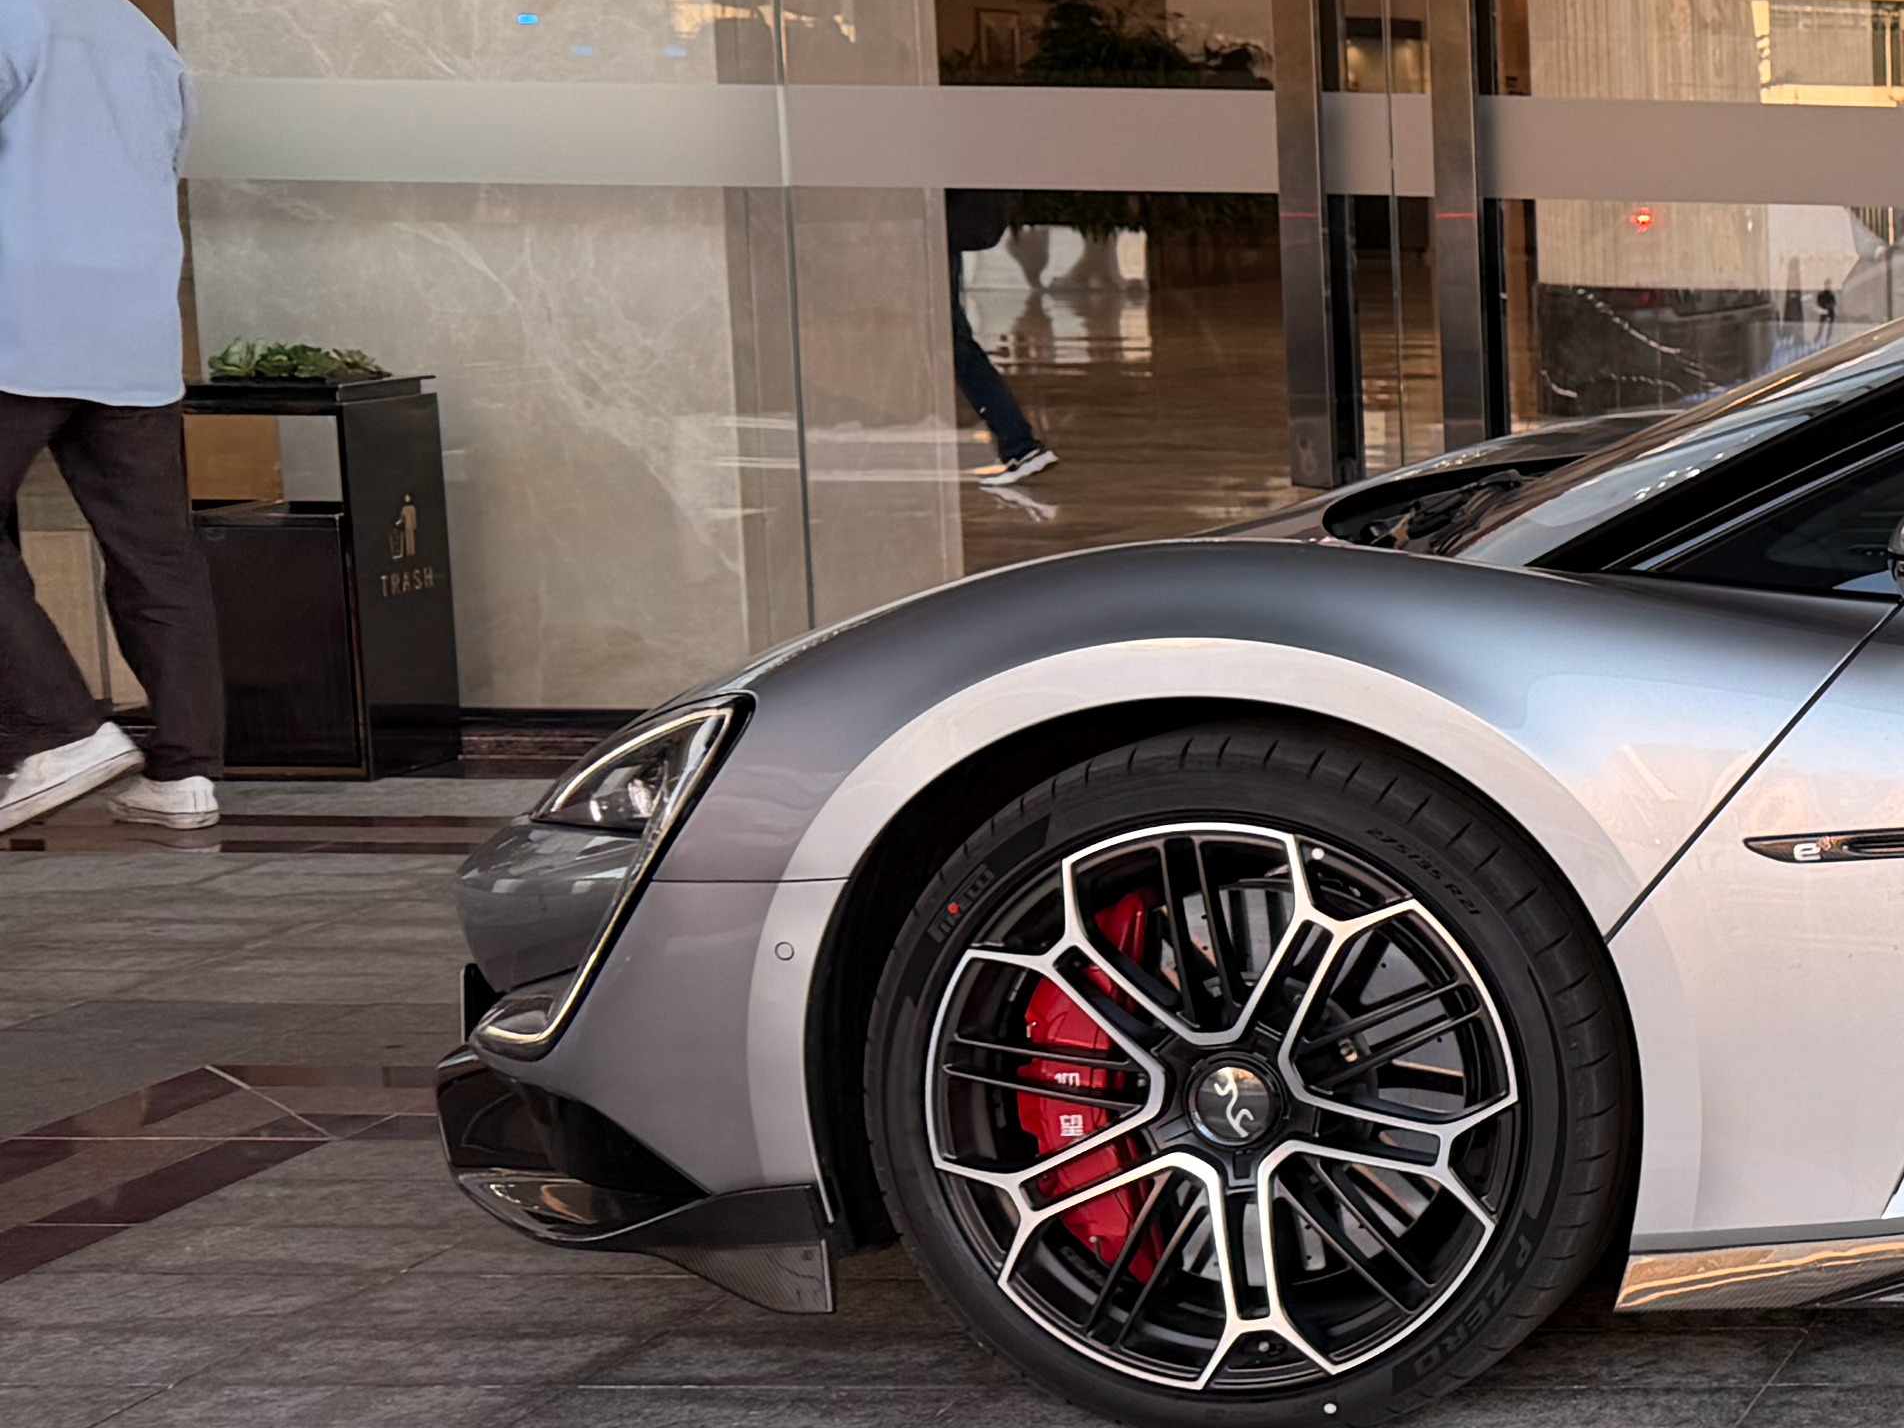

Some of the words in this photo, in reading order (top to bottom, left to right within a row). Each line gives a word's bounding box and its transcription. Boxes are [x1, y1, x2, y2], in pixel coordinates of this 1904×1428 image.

[380, 566, 434, 597] TRASH
[1365, 828, 1441, 880] 275/35
[1445, 883, 1481, 915] R21
[1515, 1234, 1533, 1269] P
[1413, 1271, 1511, 1377] ZERO
